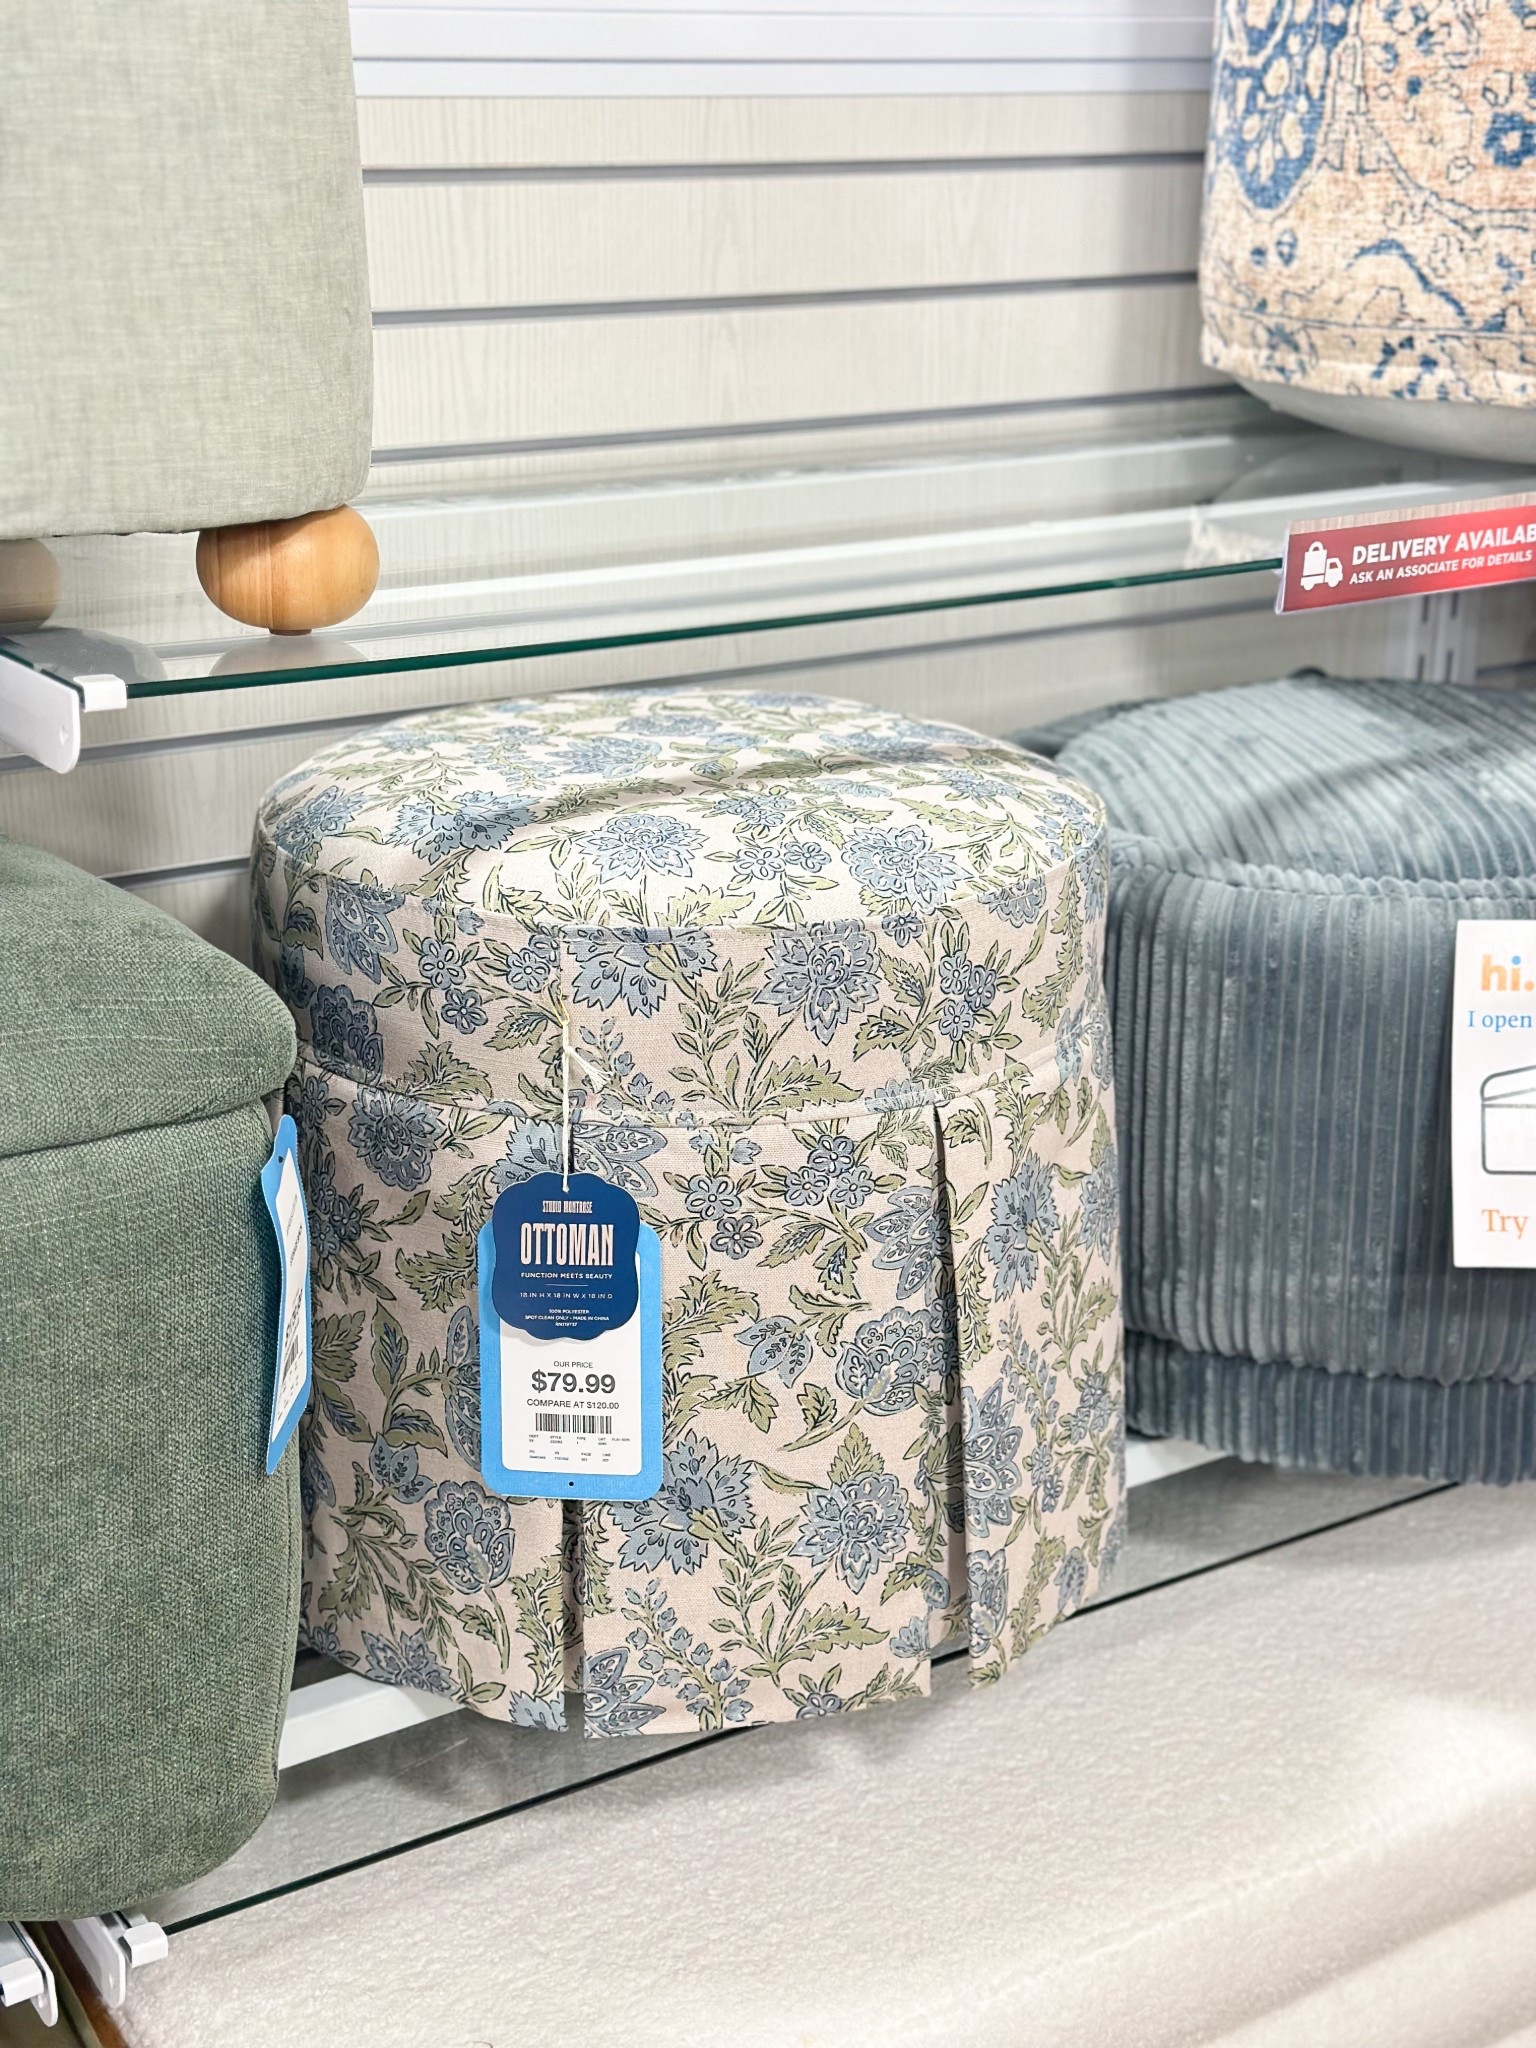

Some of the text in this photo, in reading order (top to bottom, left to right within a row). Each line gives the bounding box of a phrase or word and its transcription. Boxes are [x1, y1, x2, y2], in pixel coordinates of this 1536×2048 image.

[1352, 534, 1451, 565] DELIVERY
[1349, 549, 1533, 585] ASK AN ASSOCIATE FOR DETAILS
[1481, 953, 1535, 992] hi.
[1468, 1010, 1532, 1033] I open
[542, 1200, 593, 1214] STUDIO MONTROSE
[1481, 1208, 1529, 1240] Try
[520, 1222, 614, 1266] OTTOMAN
[553, 1360, 594, 1369] OUR PRICE
[531, 1369, 616, 1394] $79.99
[526, 1398, 620, 1410] COMPARE AT $120.00
